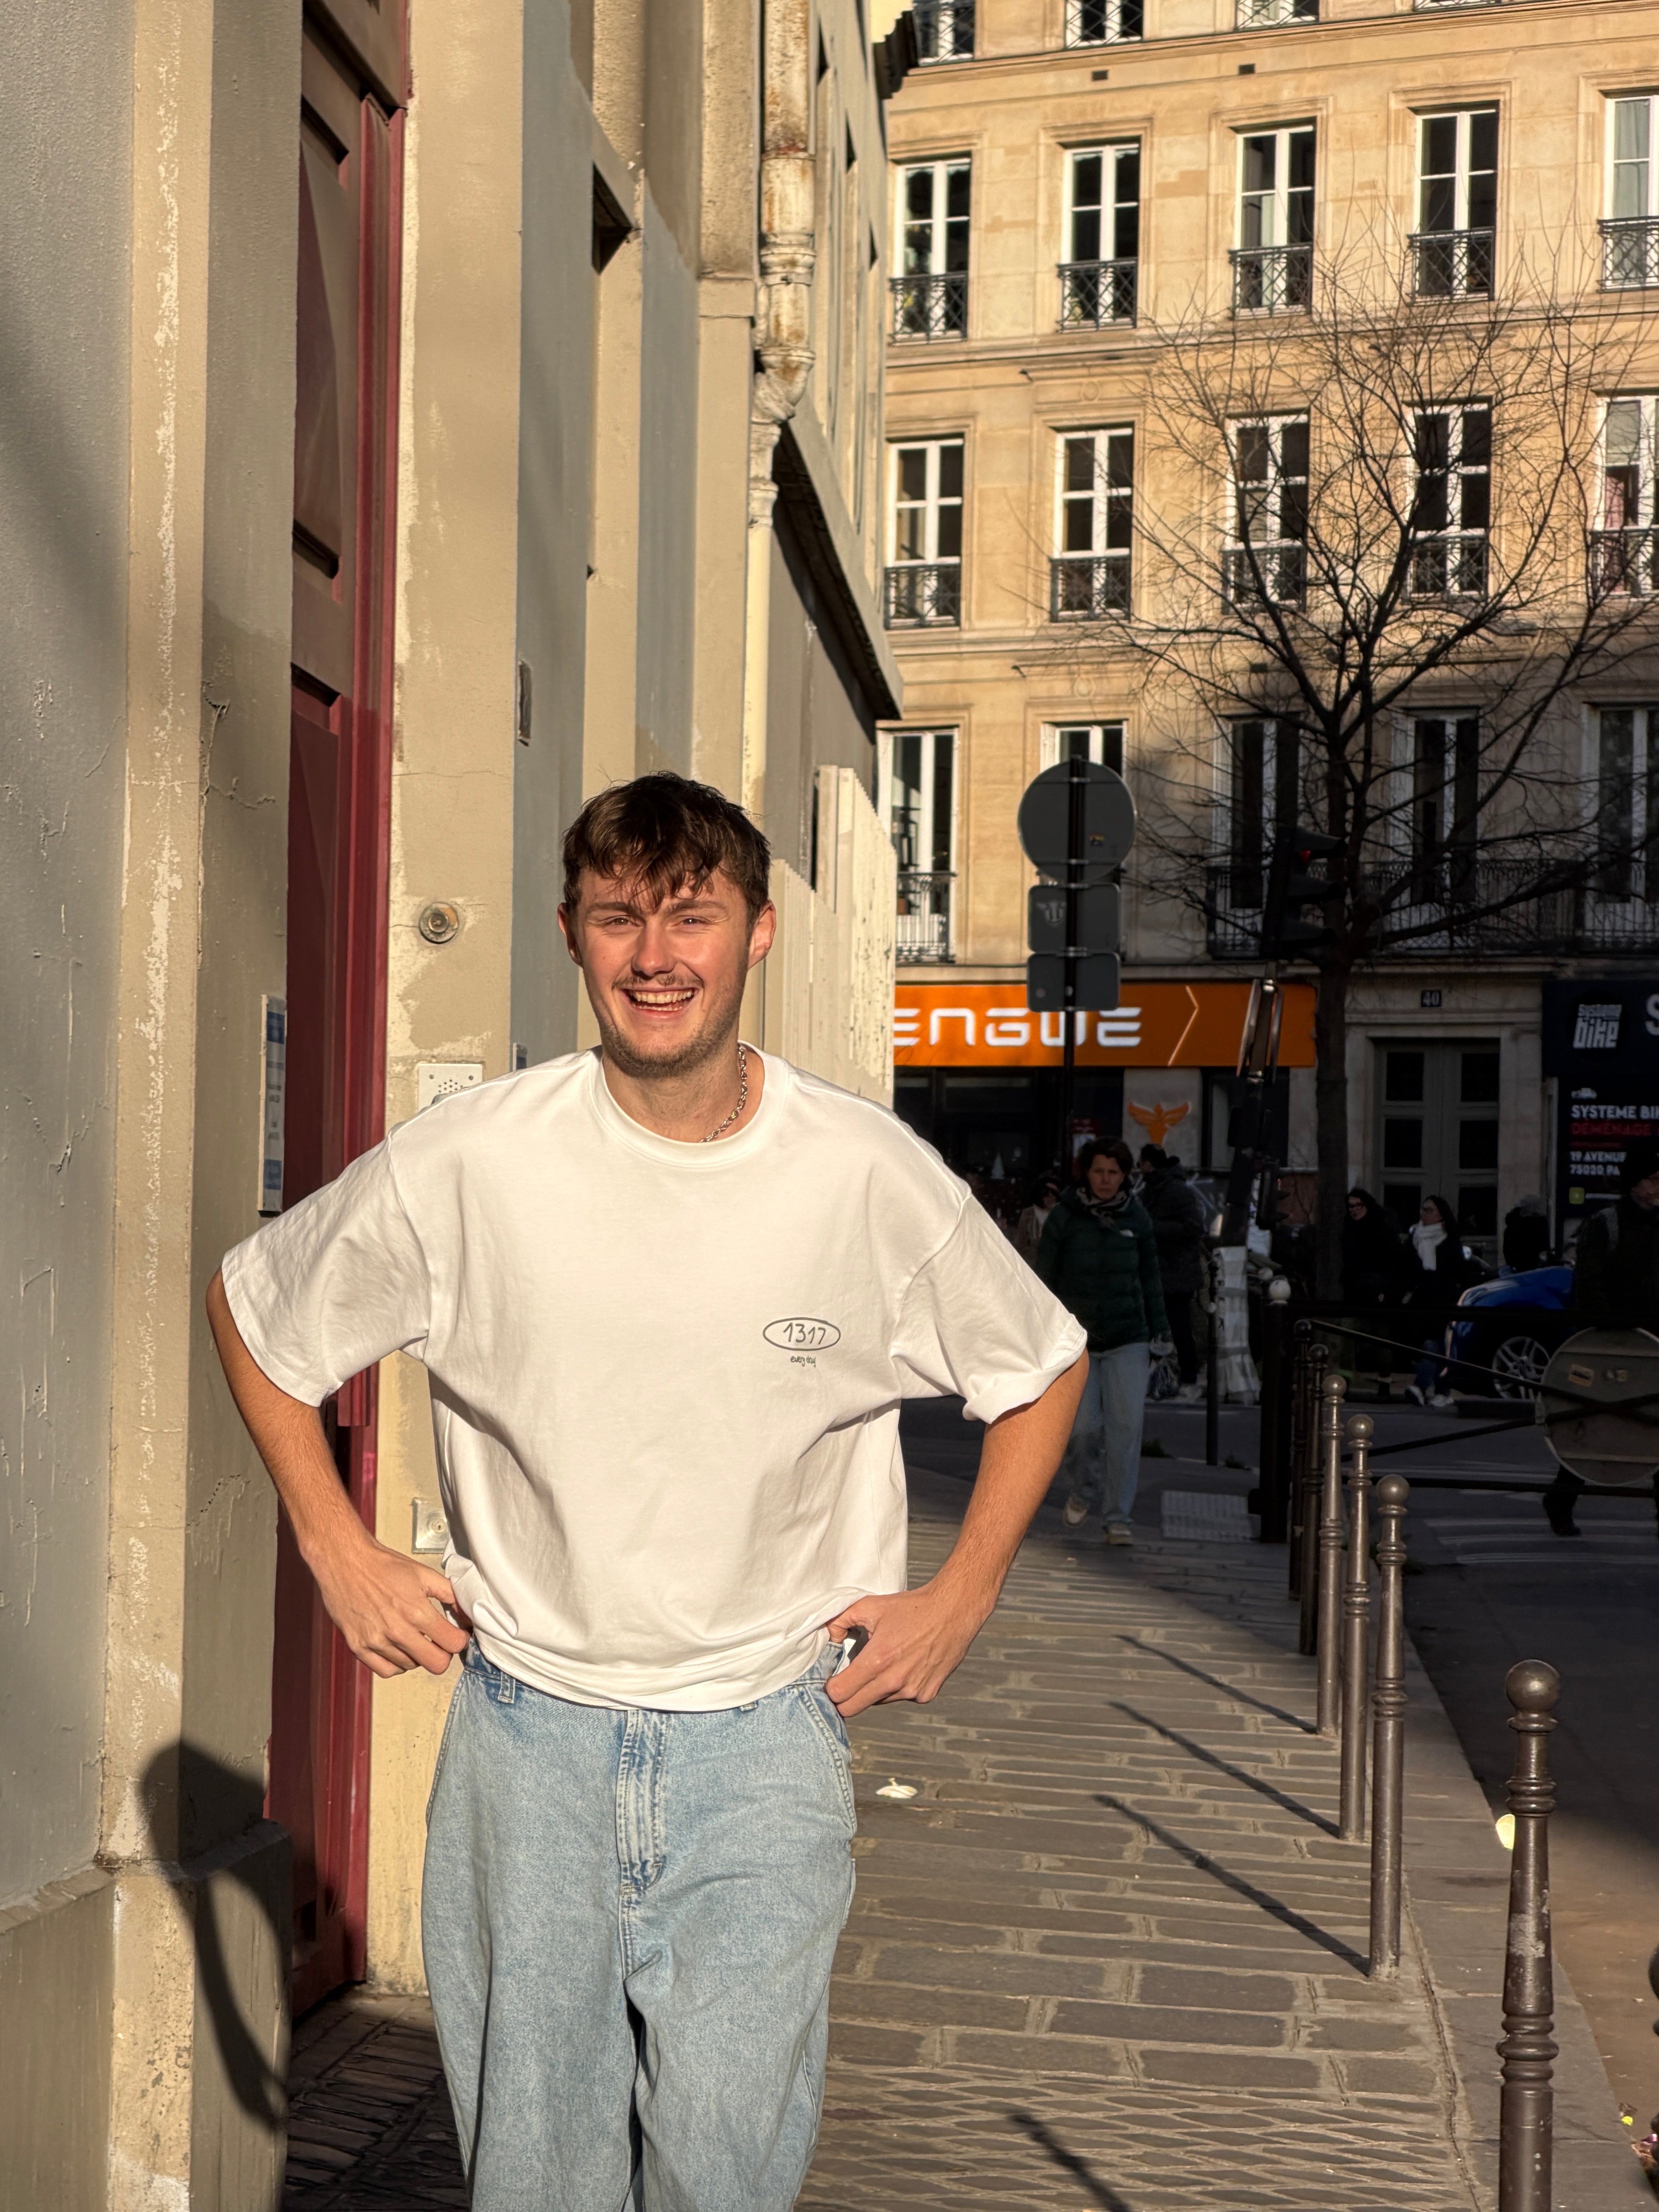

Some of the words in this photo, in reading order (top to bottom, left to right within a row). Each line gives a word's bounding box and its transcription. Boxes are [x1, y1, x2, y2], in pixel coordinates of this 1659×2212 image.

[1423, 991, 1440, 1006] 40
[1573, 1017, 1620, 1049] bike
[1571, 1104, 1637, 1120] SYSTEME
[783, 1322, 826, 1345] 1317
